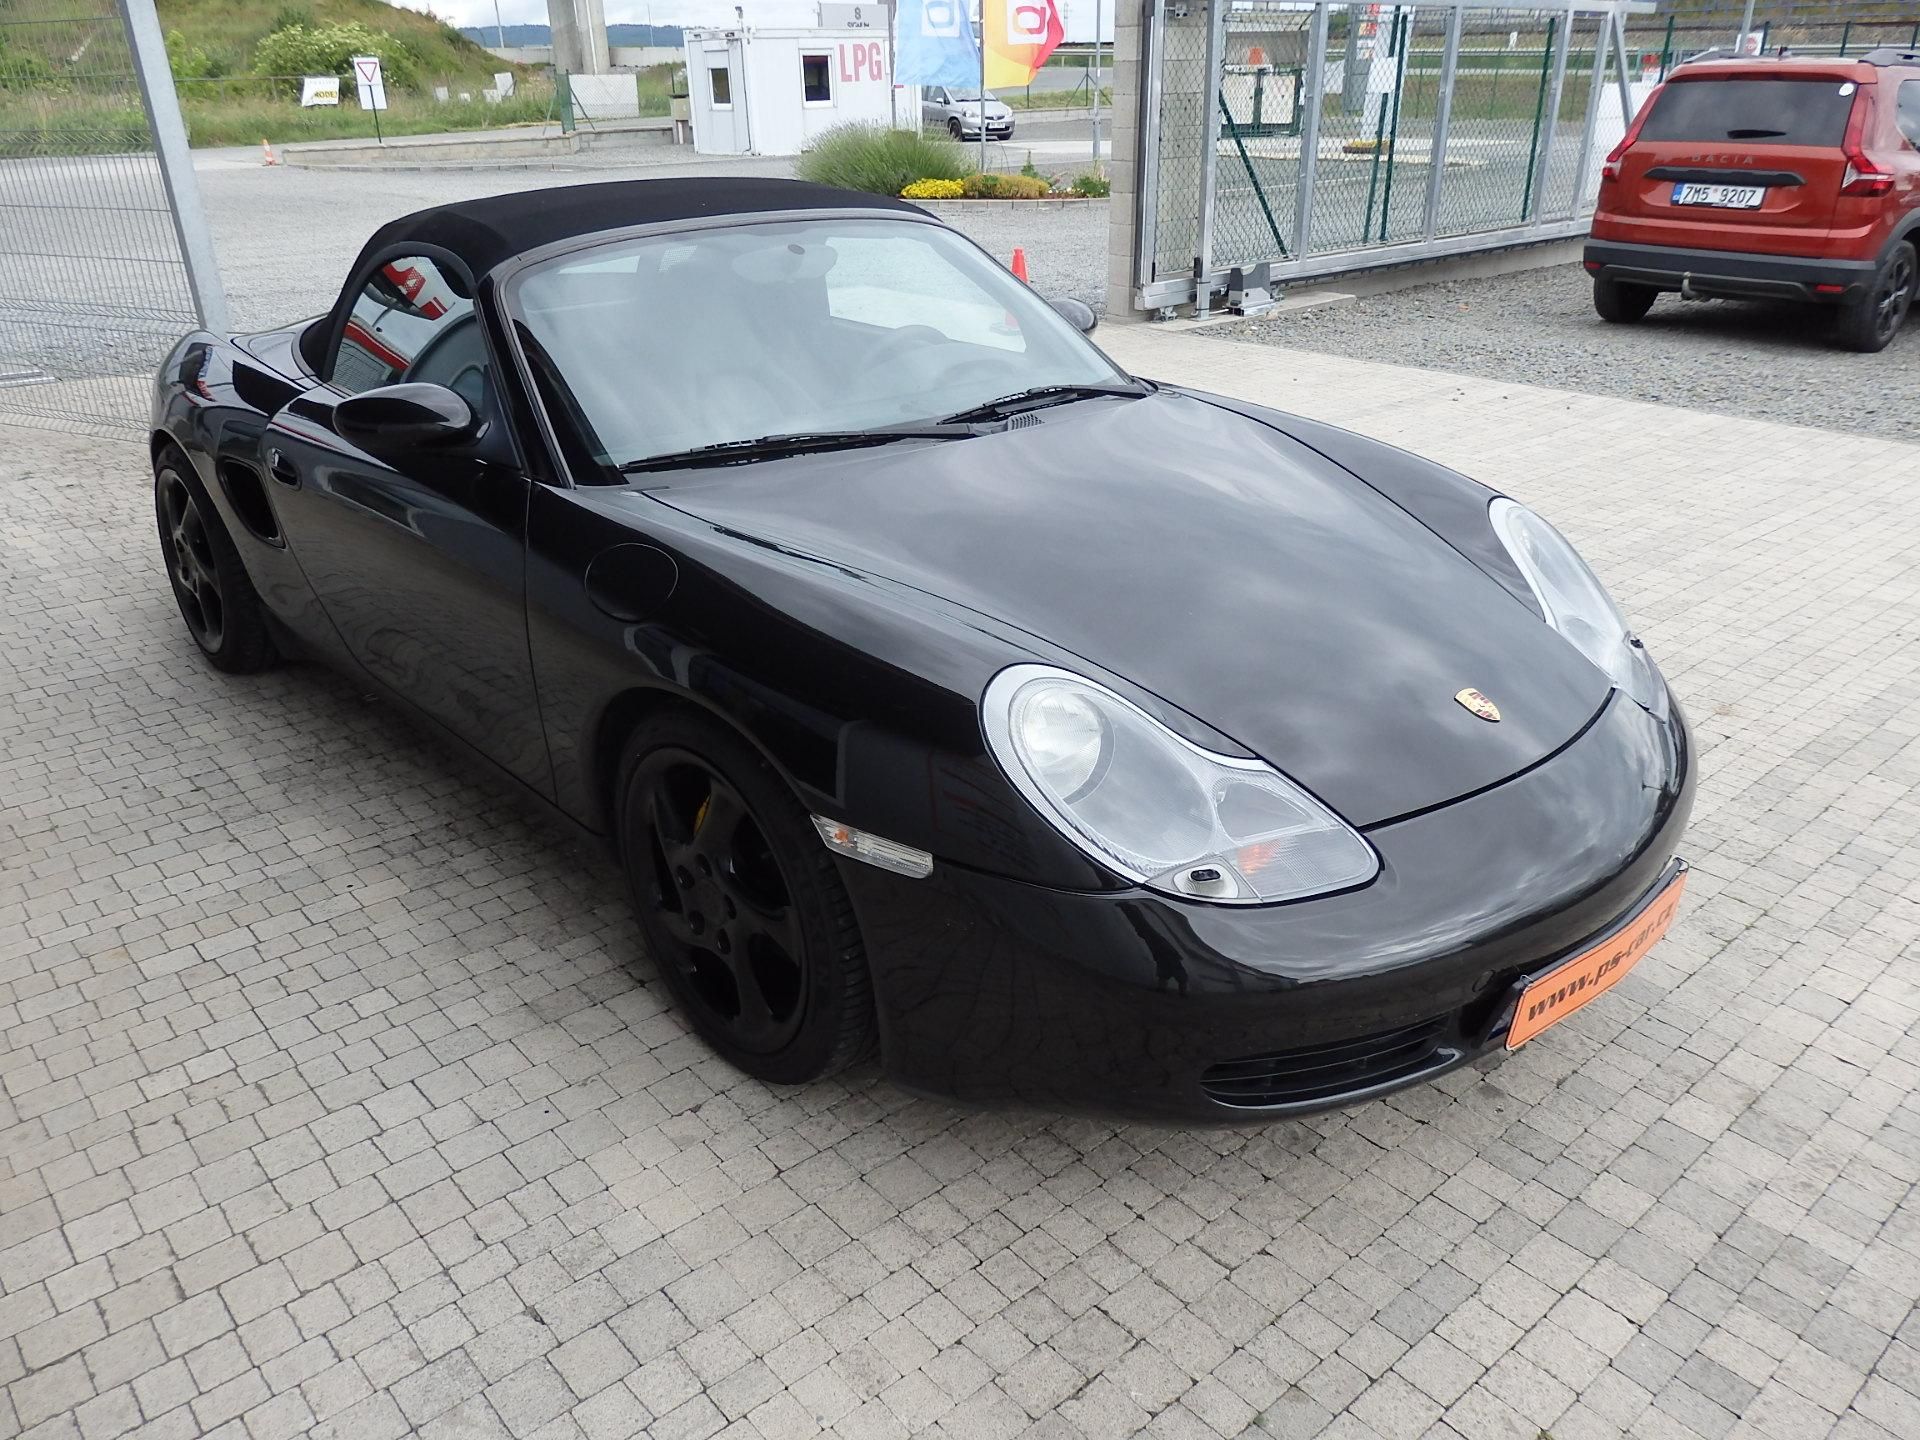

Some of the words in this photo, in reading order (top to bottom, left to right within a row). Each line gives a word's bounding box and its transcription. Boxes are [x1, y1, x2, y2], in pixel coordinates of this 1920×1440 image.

[839, 42, 882, 82] LPG
[1691, 153, 1753, 165] DACIA
[1684, 186, 1710, 201] 7M5
[1720, 188, 1756, 204] 9207
[1528, 902, 1674, 1021] www.ps-car.cz
